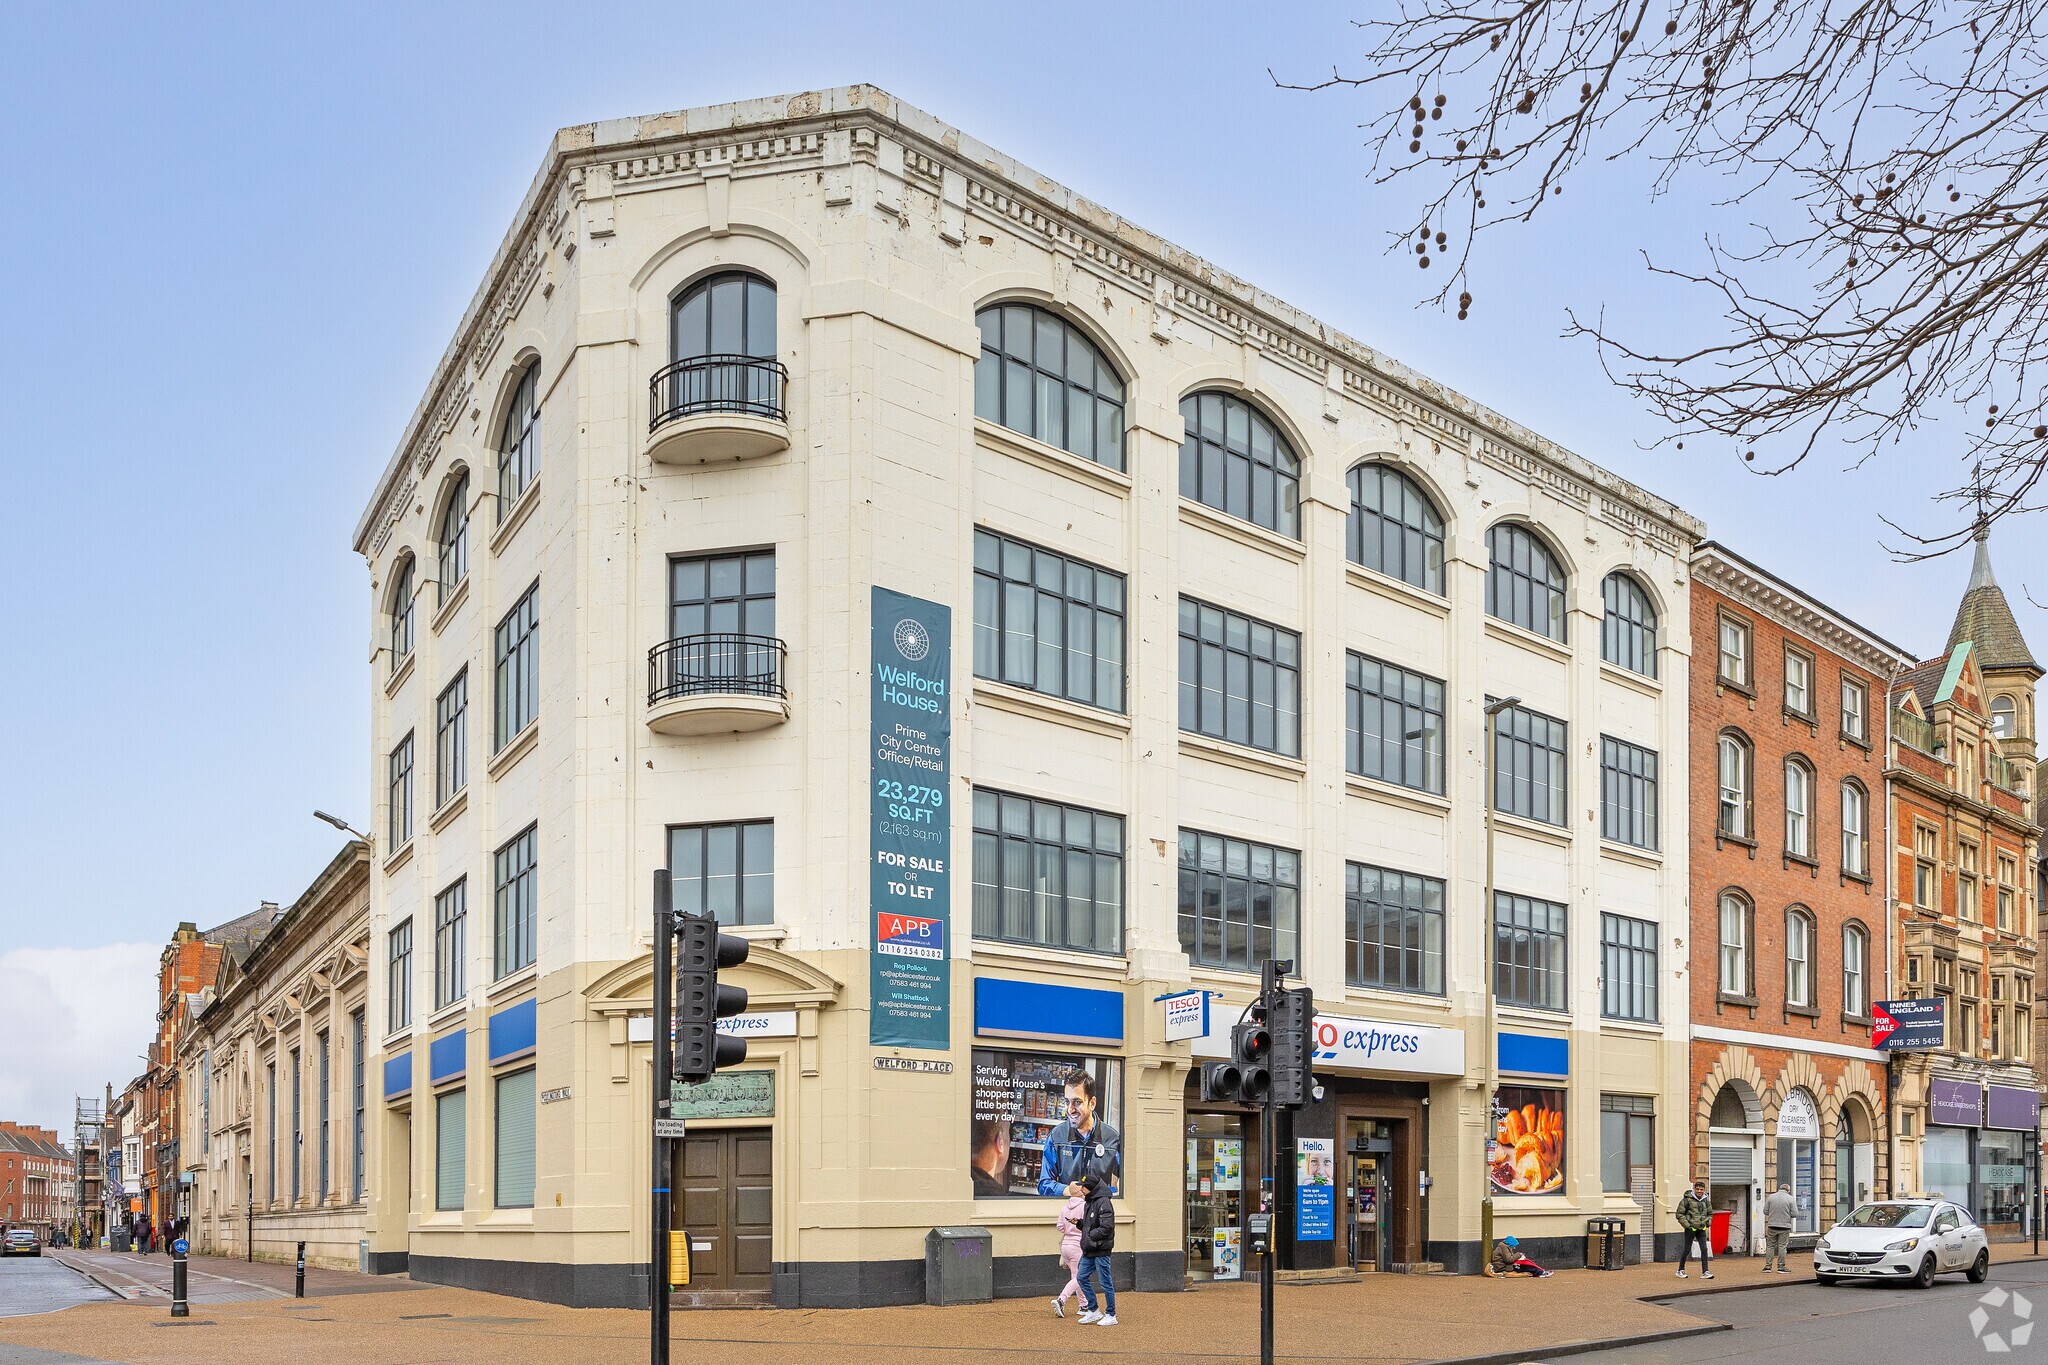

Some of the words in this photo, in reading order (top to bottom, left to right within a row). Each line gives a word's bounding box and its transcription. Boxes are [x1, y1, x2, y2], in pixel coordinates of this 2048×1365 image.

[878, 663, 944, 695] Welford
[883, 684, 942, 714] House.
[896, 723, 926, 740] Prime
[880, 734, 901, 750] City
[905, 739, 940, 756] Centre
[878, 749, 943, 771] Office/Retail
[878, 779, 943, 807] 23,279
[889, 803, 933, 824] SQ.FT
[880, 821, 910, 836] (2,163
[878, 851, 906, 867] FOR
[909, 856, 944, 873] SALE
[904, 872, 917, 881] OR
[888, 881, 907, 896] TO
[910, 884, 934, 900] LET
[890, 918, 931, 937] APB
[880, 944, 901, 954] 0116
[904, 947, 918, 955] 254
[920, 949, 941, 958] 0382
[893, 962, 905, 971] Reg
[906, 964, 928, 972] Pollock
[903, 993, 930, 1002] Shattock
[1168, 996, 1200, 1010] TESCO
[1890, 1006, 1934, 1014] ENGLAND
[716, 1017, 769, 1033] express
[1170, 1013, 1199, 1026] express
[1875, 1024, 1895, 1032] SALE
[1343, 1028, 1419, 1058] express
[1906, 1038, 1920, 1046] 255
[877, 1059, 918, 1070] WELFORD
[922, 1062, 950, 1072] PLACE
[976, 1064, 1007, 1077] Serving
[976, 1076, 1010, 1087] Welford
[1012, 1079, 1045, 1089] House's
[975, 1088, 1015, 1100] shoppers
[975, 1099, 994, 1109] little
[996, 1100, 1022, 1110] better
[1789, 1104, 1799, 1112] DRY
[975, 1112, 1000, 1123] every
[1001, 1112, 1016, 1123] day
[1782, 1115, 1807, 1124] CLEANERS
[665, 1121, 683, 1129] loading
[1302, 1141, 1325, 1151] Hello.
